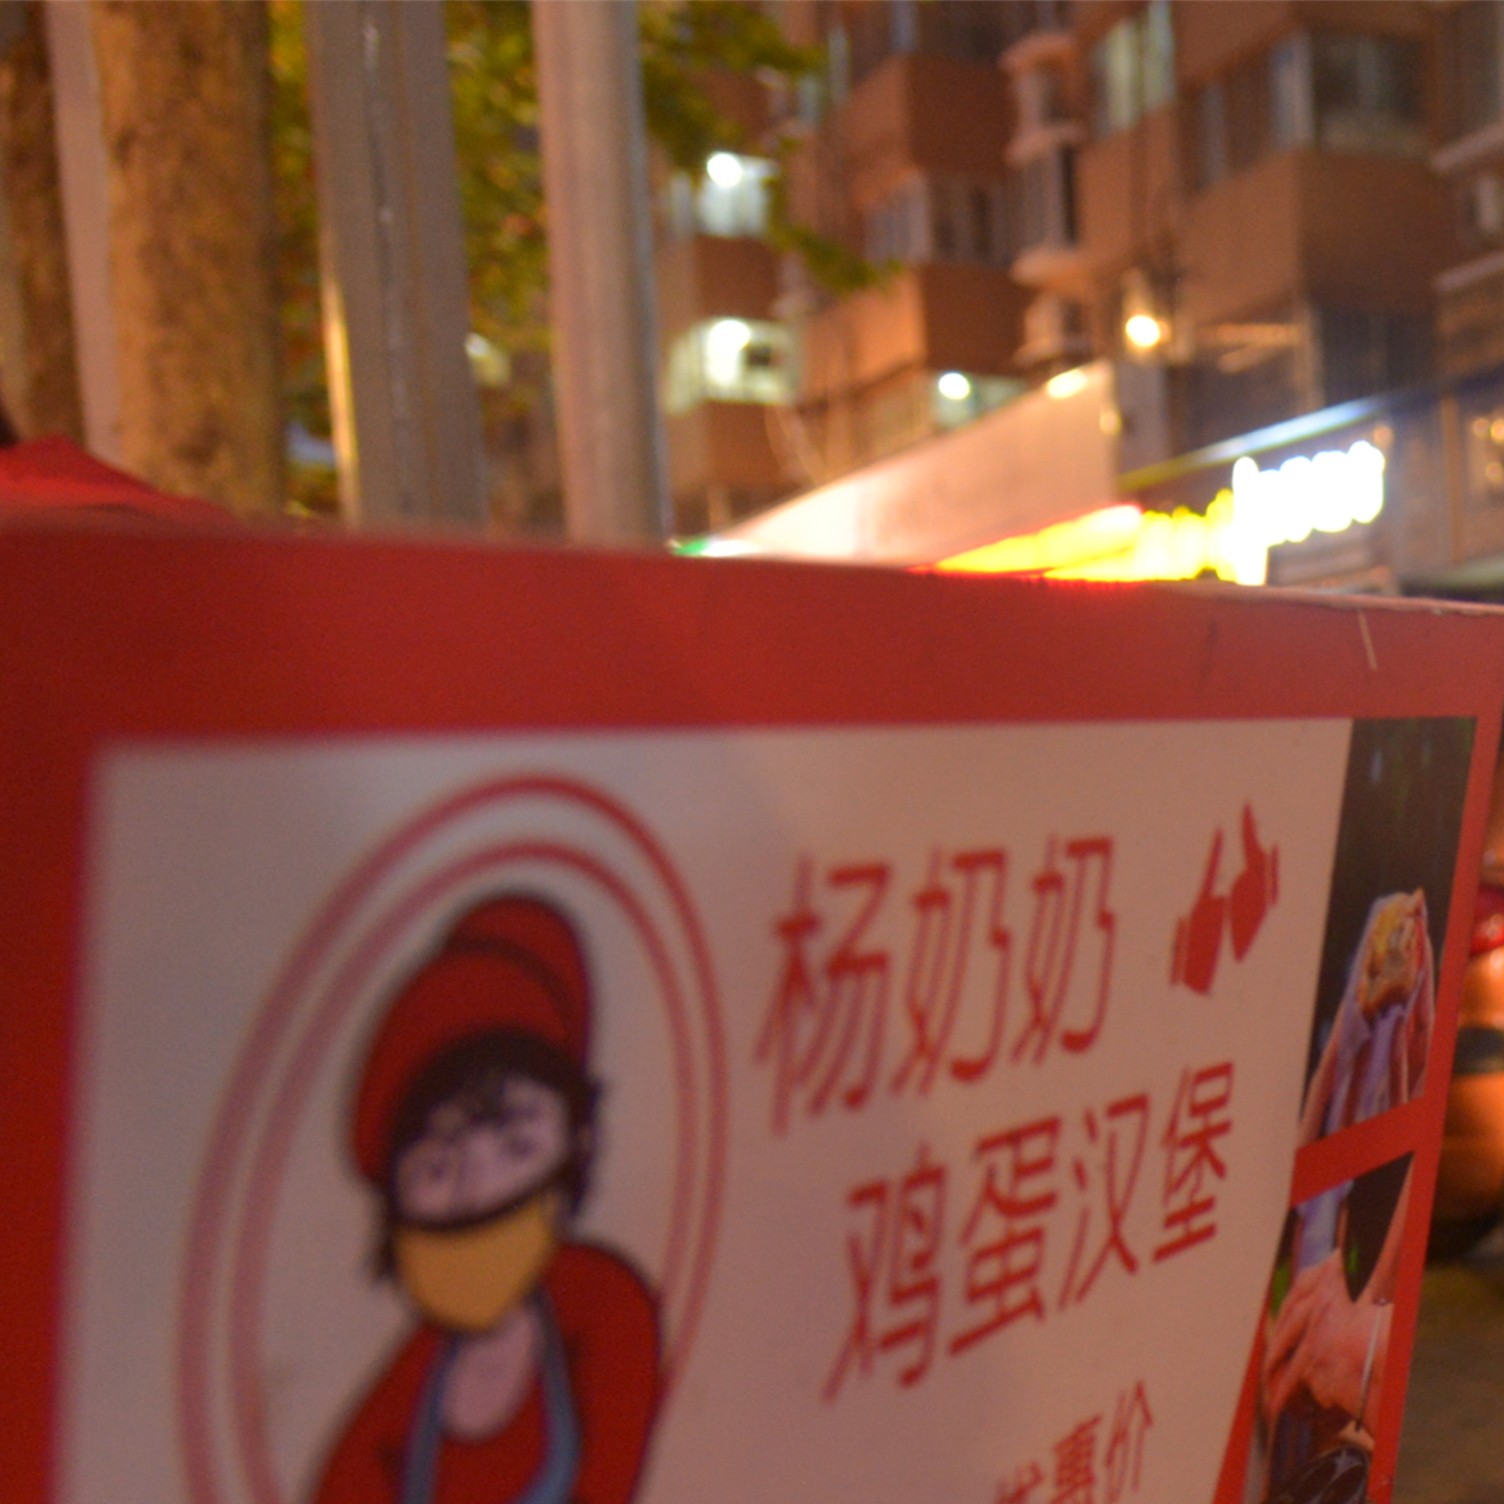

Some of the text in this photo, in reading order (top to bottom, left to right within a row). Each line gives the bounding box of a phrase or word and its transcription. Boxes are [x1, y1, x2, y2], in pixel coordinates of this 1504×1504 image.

[755, 832, 1115, 1136] 杨奶奶
[820, 1060, 1235, 1407] 鸡蛋汉堡
